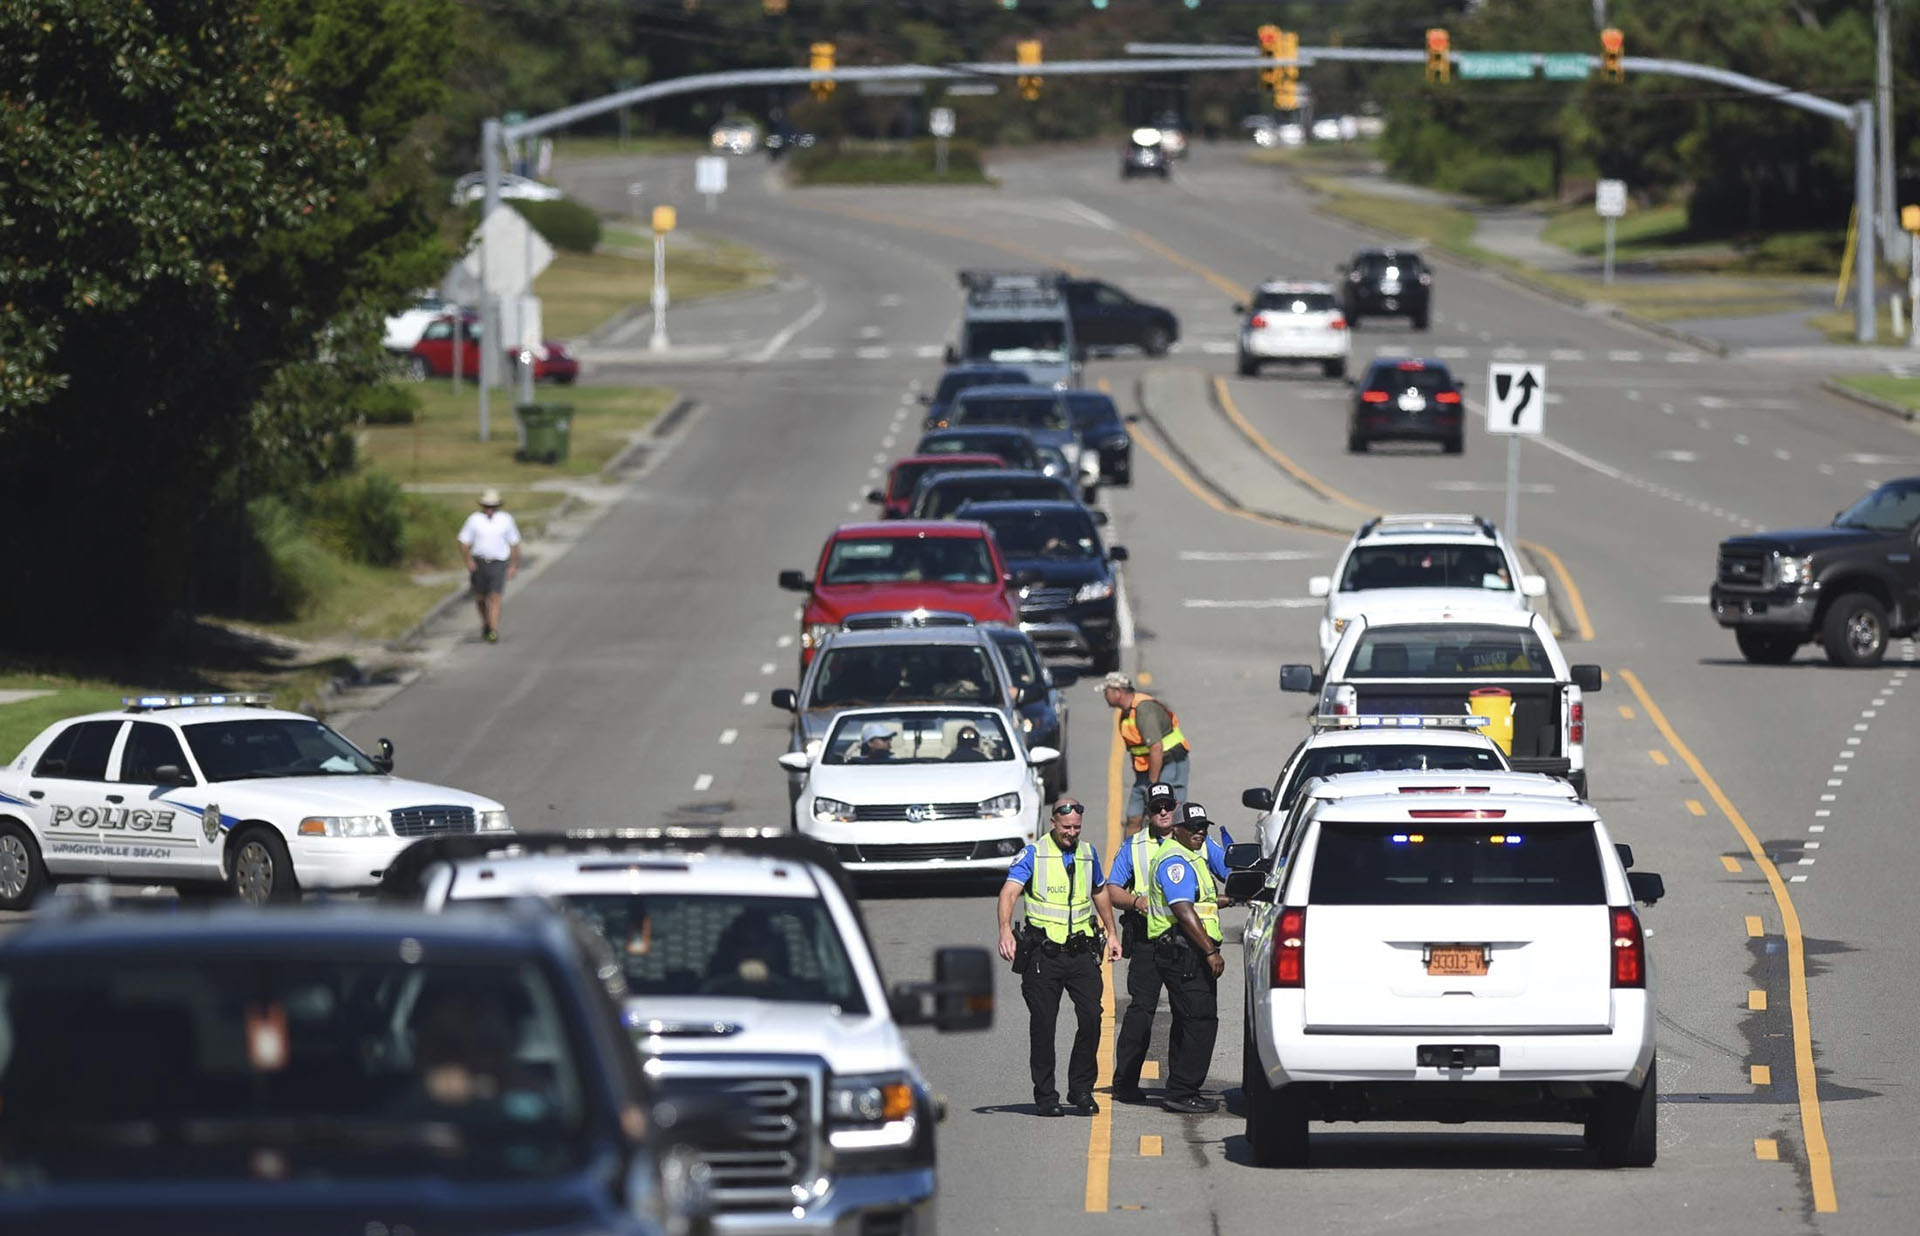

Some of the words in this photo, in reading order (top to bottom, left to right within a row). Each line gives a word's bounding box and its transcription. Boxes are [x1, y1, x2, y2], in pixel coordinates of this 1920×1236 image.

[50, 804, 175, 833] POLICE
[52, 843, 130, 857] WRIGHTSVILLE
[133, 847, 171, 859] BEACH
[1047, 885, 1067, 893] POLICE
[1433, 953, 1481, 969] 93313-V
